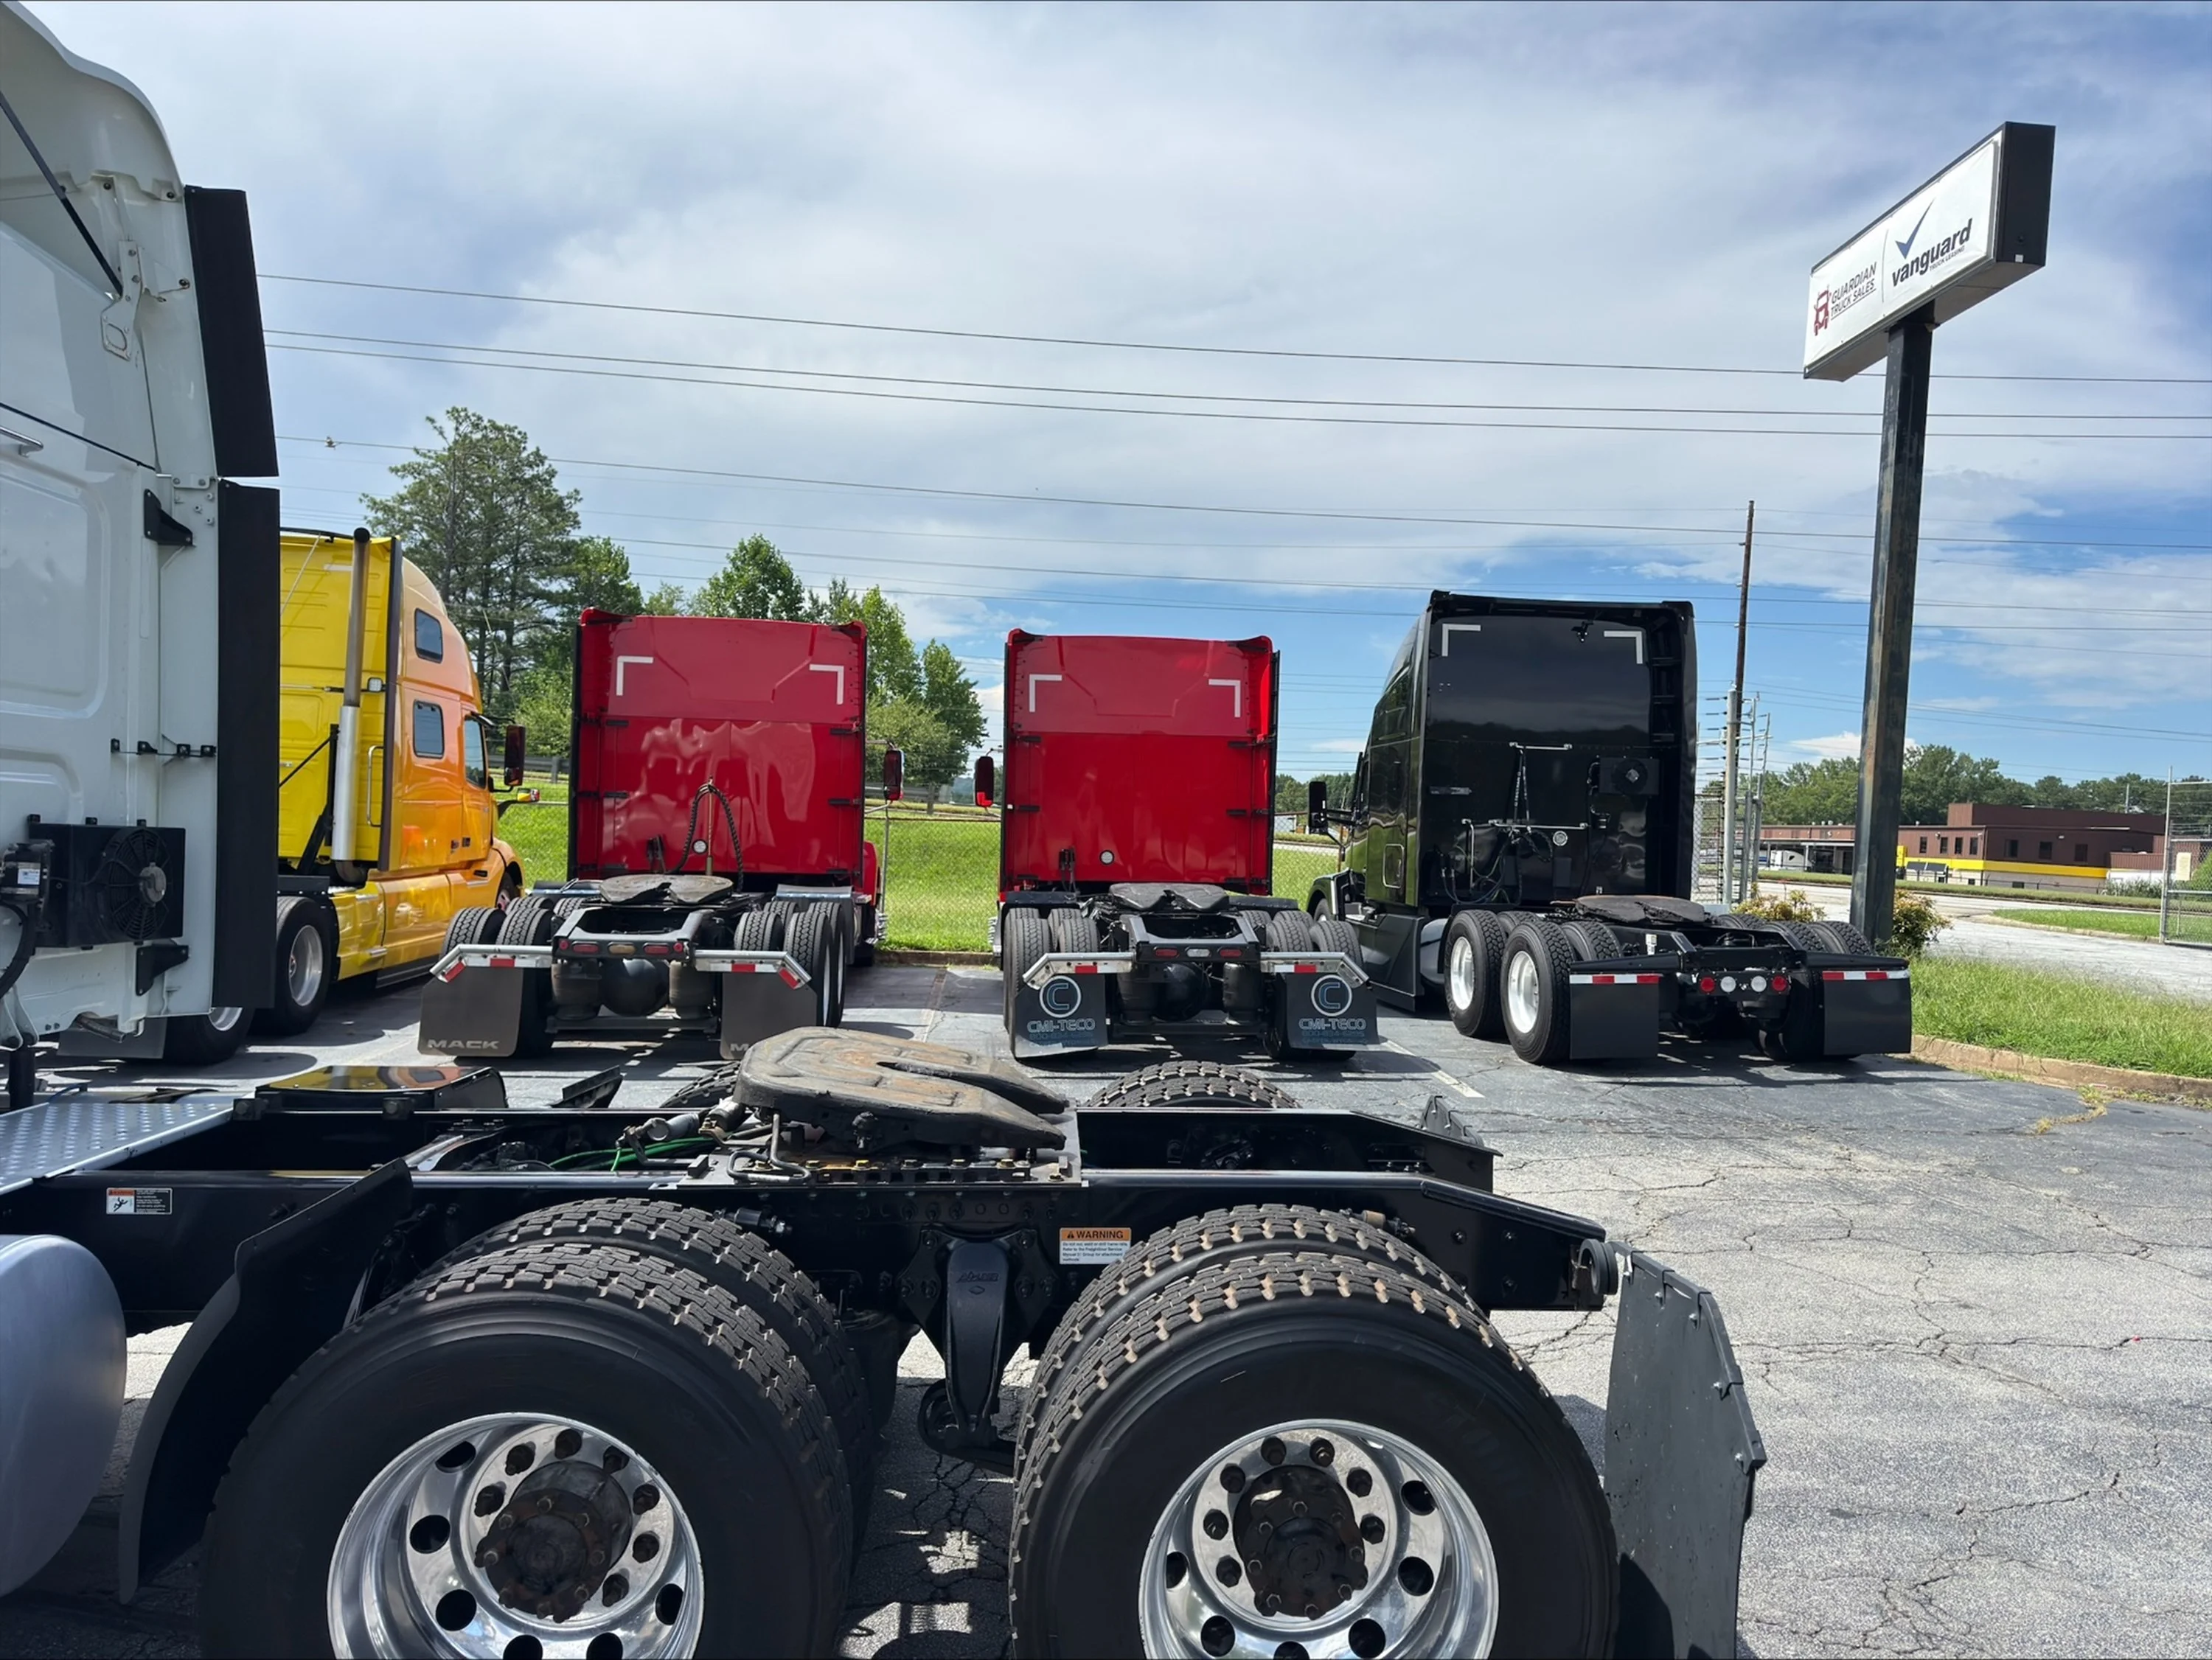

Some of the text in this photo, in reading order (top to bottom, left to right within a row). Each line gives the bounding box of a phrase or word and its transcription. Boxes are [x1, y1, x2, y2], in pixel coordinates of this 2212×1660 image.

[1892, 217, 1972, 287] vanguard
[1832, 261, 1877, 304] GUARDIAN
[1831, 278, 1875, 317] TRUCK SALES
[1027, 1018, 1096, 1033] CMI-TECO
[1298, 1018, 1366, 1030] CMI-TECO
[428, 1039, 499, 1049] MACK
[1077, 1230, 1124, 1239] WARNING
